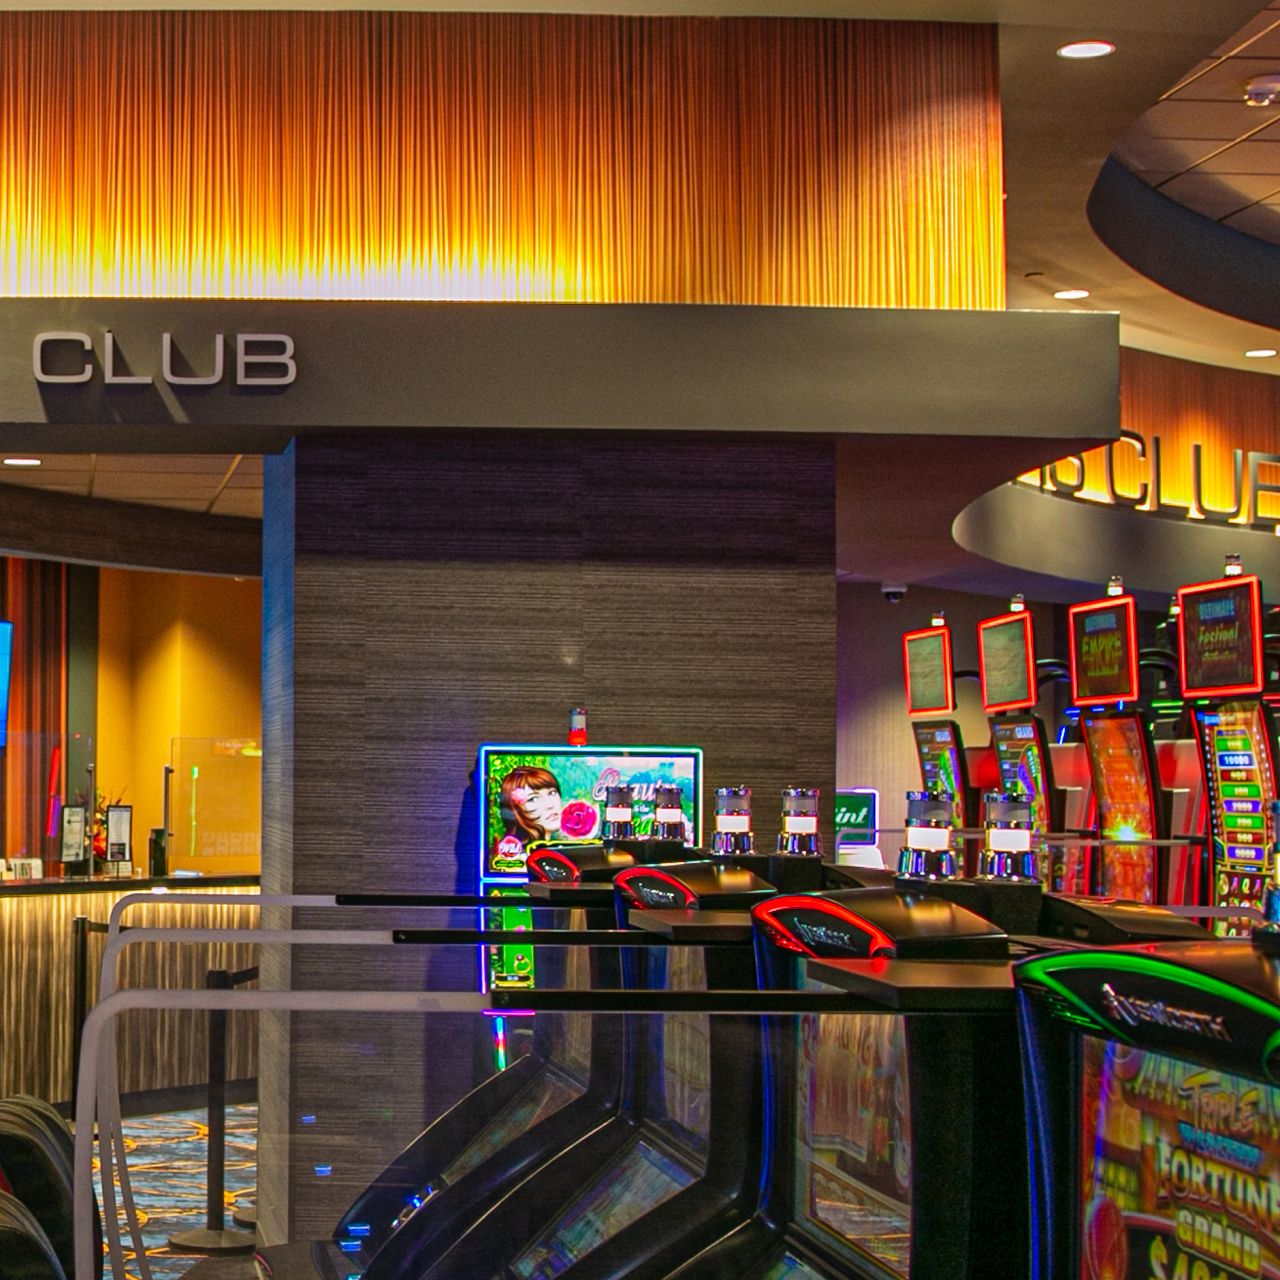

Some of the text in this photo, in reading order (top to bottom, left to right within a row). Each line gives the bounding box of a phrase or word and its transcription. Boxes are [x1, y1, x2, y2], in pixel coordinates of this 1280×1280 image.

[32, 330, 298, 387] CLUB
[835, 807, 869, 824] int
[1177, 1208, 1261, 1273] GRAND
